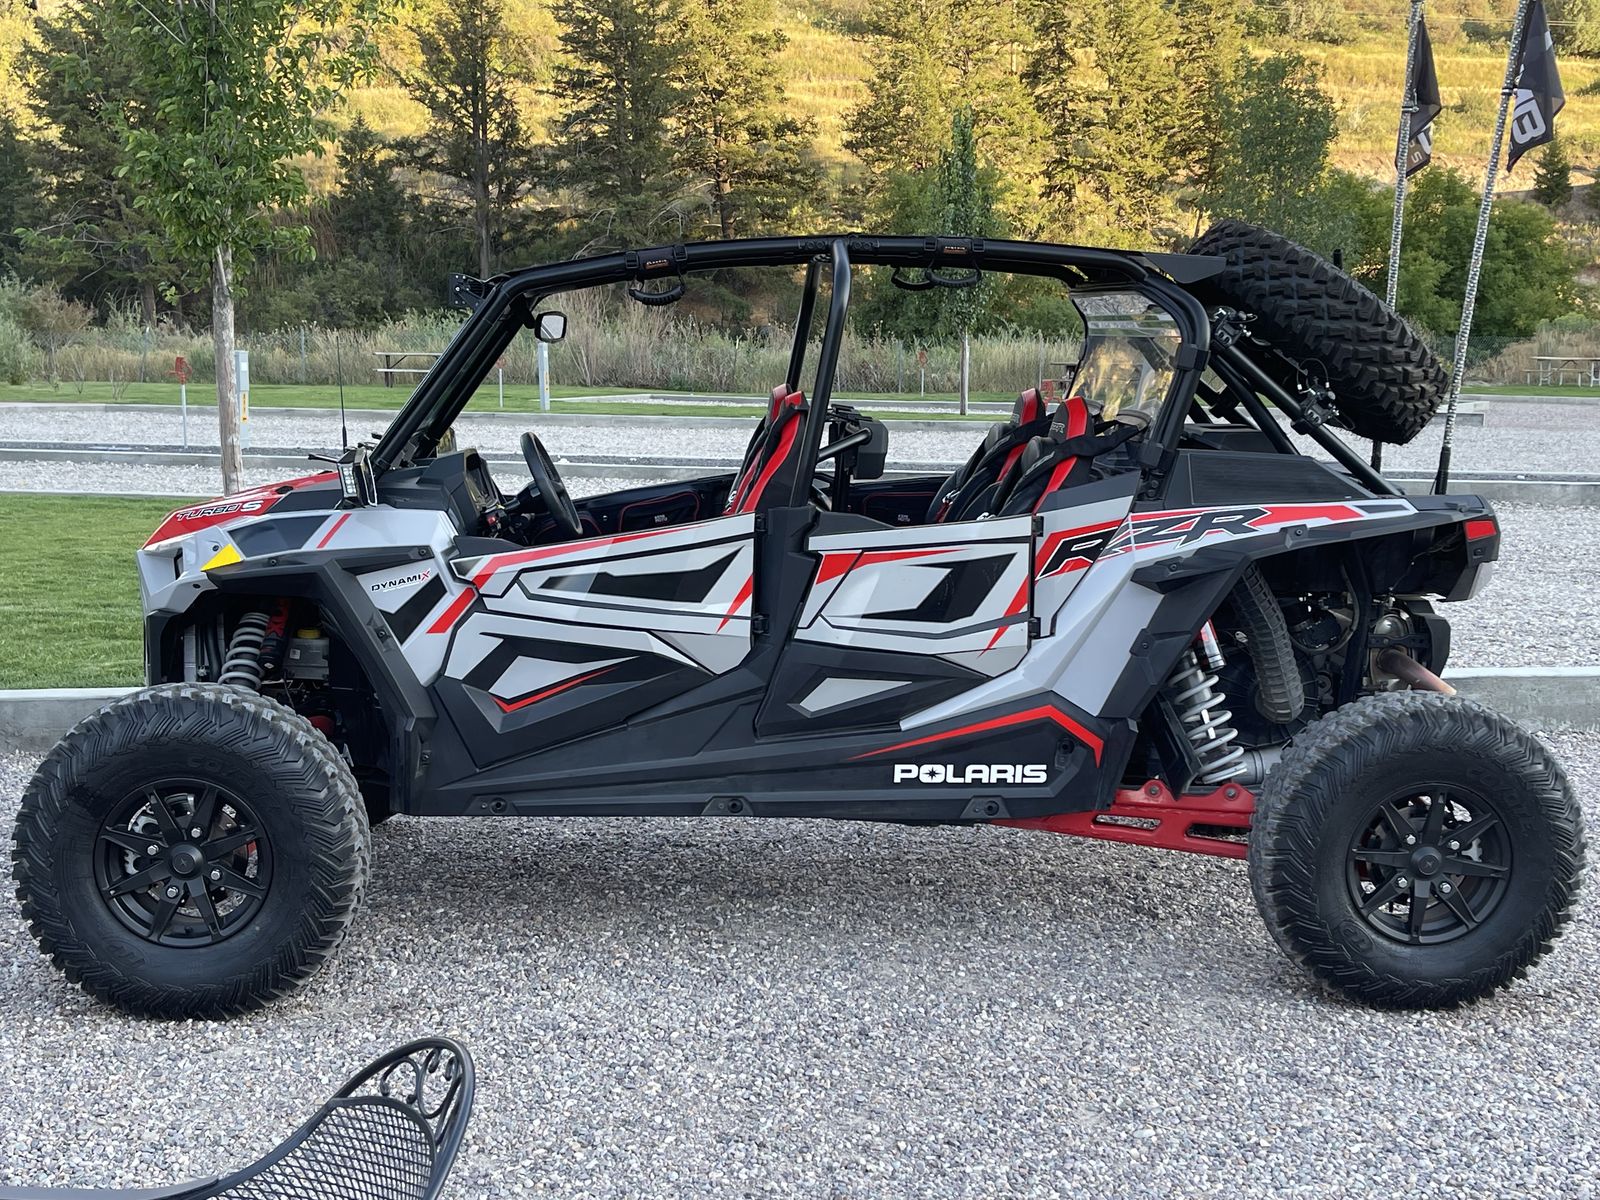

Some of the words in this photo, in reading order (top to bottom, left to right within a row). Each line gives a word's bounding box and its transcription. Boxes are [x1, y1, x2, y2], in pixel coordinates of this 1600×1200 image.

[176, 503, 242, 521] TURBO
[240, 500, 264, 512] S
[1035, 507, 1272, 581] RZR
[371, 568, 431, 591] DYNAMIX
[893, 764, 1047, 783] POLARIS
